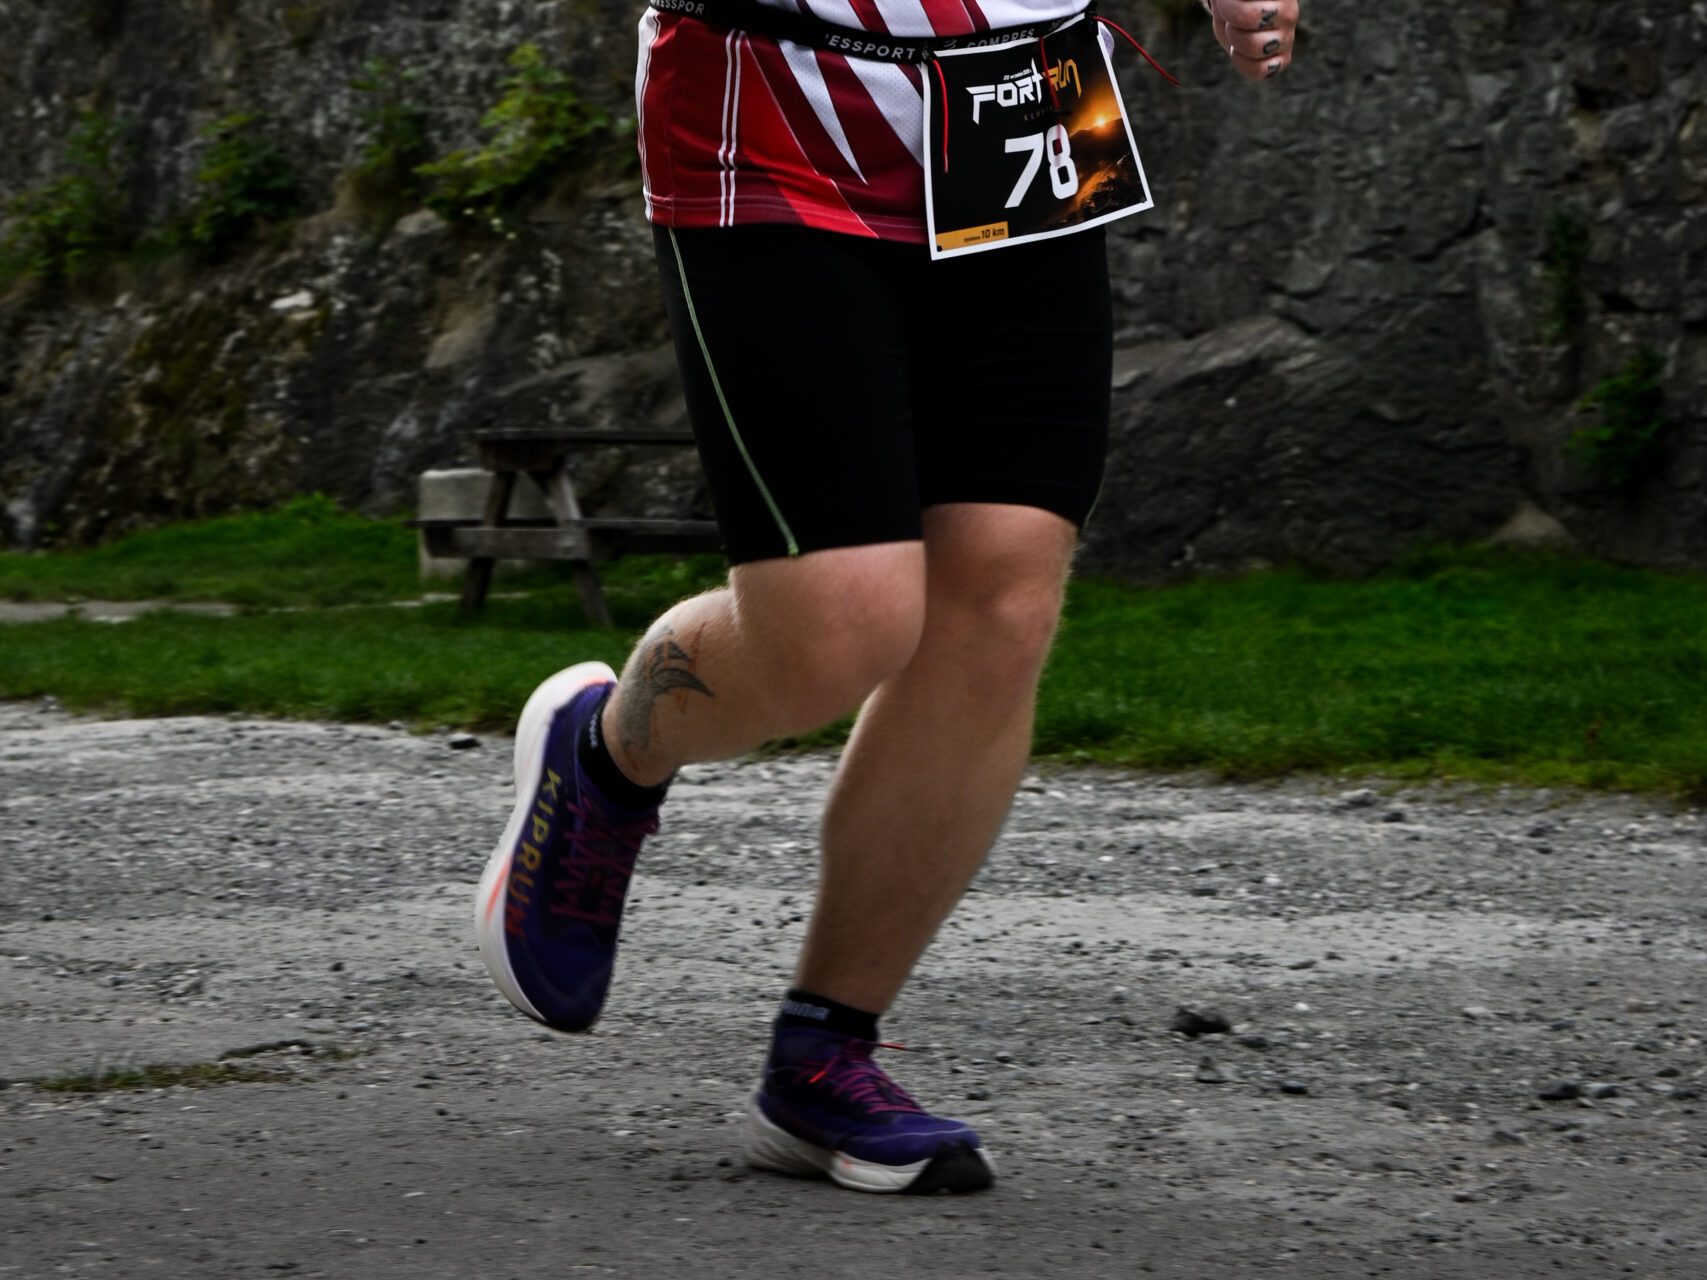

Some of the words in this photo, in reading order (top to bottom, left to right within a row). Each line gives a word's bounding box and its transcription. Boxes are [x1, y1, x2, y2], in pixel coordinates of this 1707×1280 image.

[1004, 124, 1079, 209] 78
[981, 228, 991, 239] 10
[992, 227, 1005, 237] km
[504, 767, 562, 940] KIPRUN
